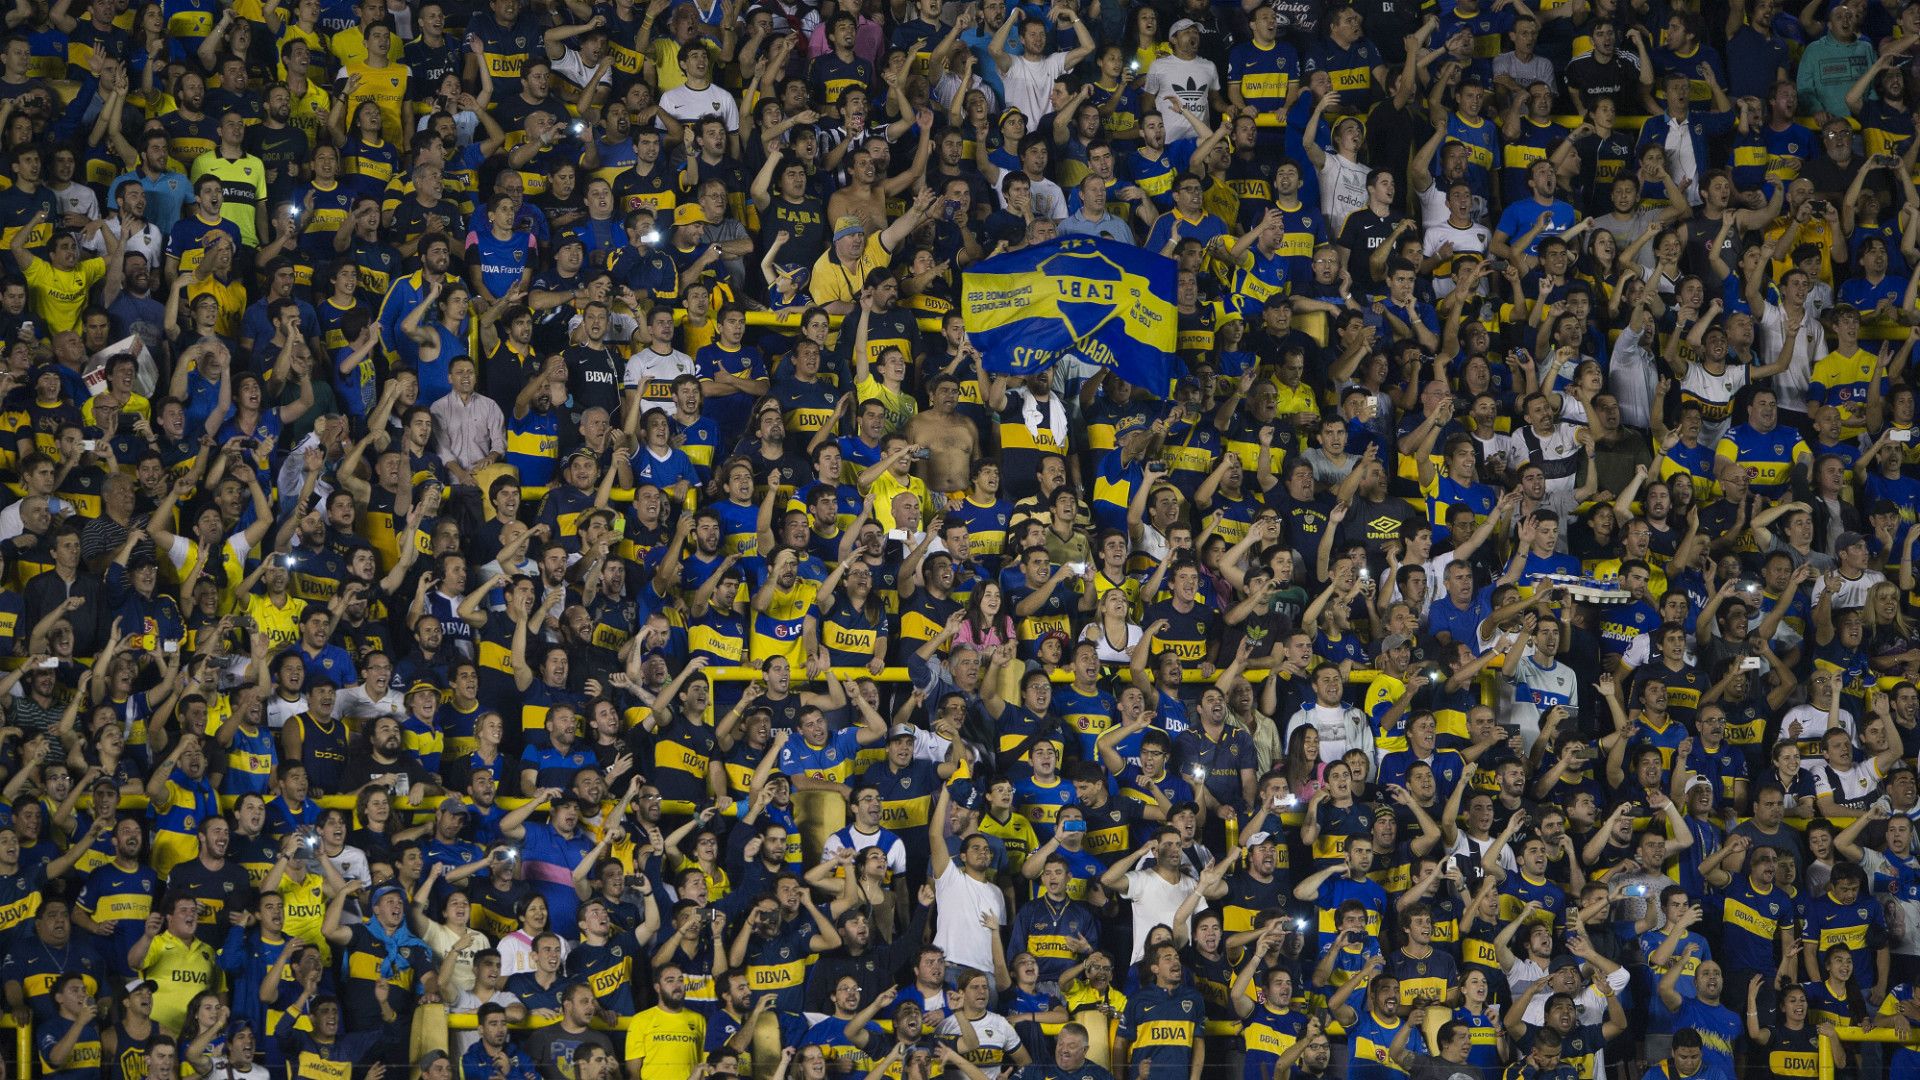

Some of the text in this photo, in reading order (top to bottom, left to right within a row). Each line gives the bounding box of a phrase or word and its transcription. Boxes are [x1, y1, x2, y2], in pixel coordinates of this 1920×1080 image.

[1272, 0, 1311, 12] Pânico
[1297, 13, 1318, 31] Surf
[492, 59, 524, 71] BBVA
[1340, 75, 1366, 85] BBVA
[1587, 87, 1613, 95] adidas
[1474, 150, 1486, 161] LG
[777, 208, 821, 223] CABJ
[925, 300, 951, 311] BBVA
[585, 371, 613, 384] BBVA
[650, 384, 672, 397] BBV
[1853, 388, 1866, 397] LG
[1761, 468, 1775, 478] LG
[1275, 600, 1301, 617] GAP
[1600, 620, 1640, 636] BOCA JRS
[836, 631, 870, 646] BBVA
[1543, 695, 1557, 706] LG
[1092, 719, 1106, 729] LG
[1723, 726, 1756, 740] BBVA
[288, 905, 322, 917] BBVA
[1479, 945, 1495, 960] BB
[172, 970, 208, 985] BBVA
[755, 970, 791, 984] BBVA
[1151, 1027, 1186, 1040] BBVA
[1785, 1058, 1815, 1070] BBVA
